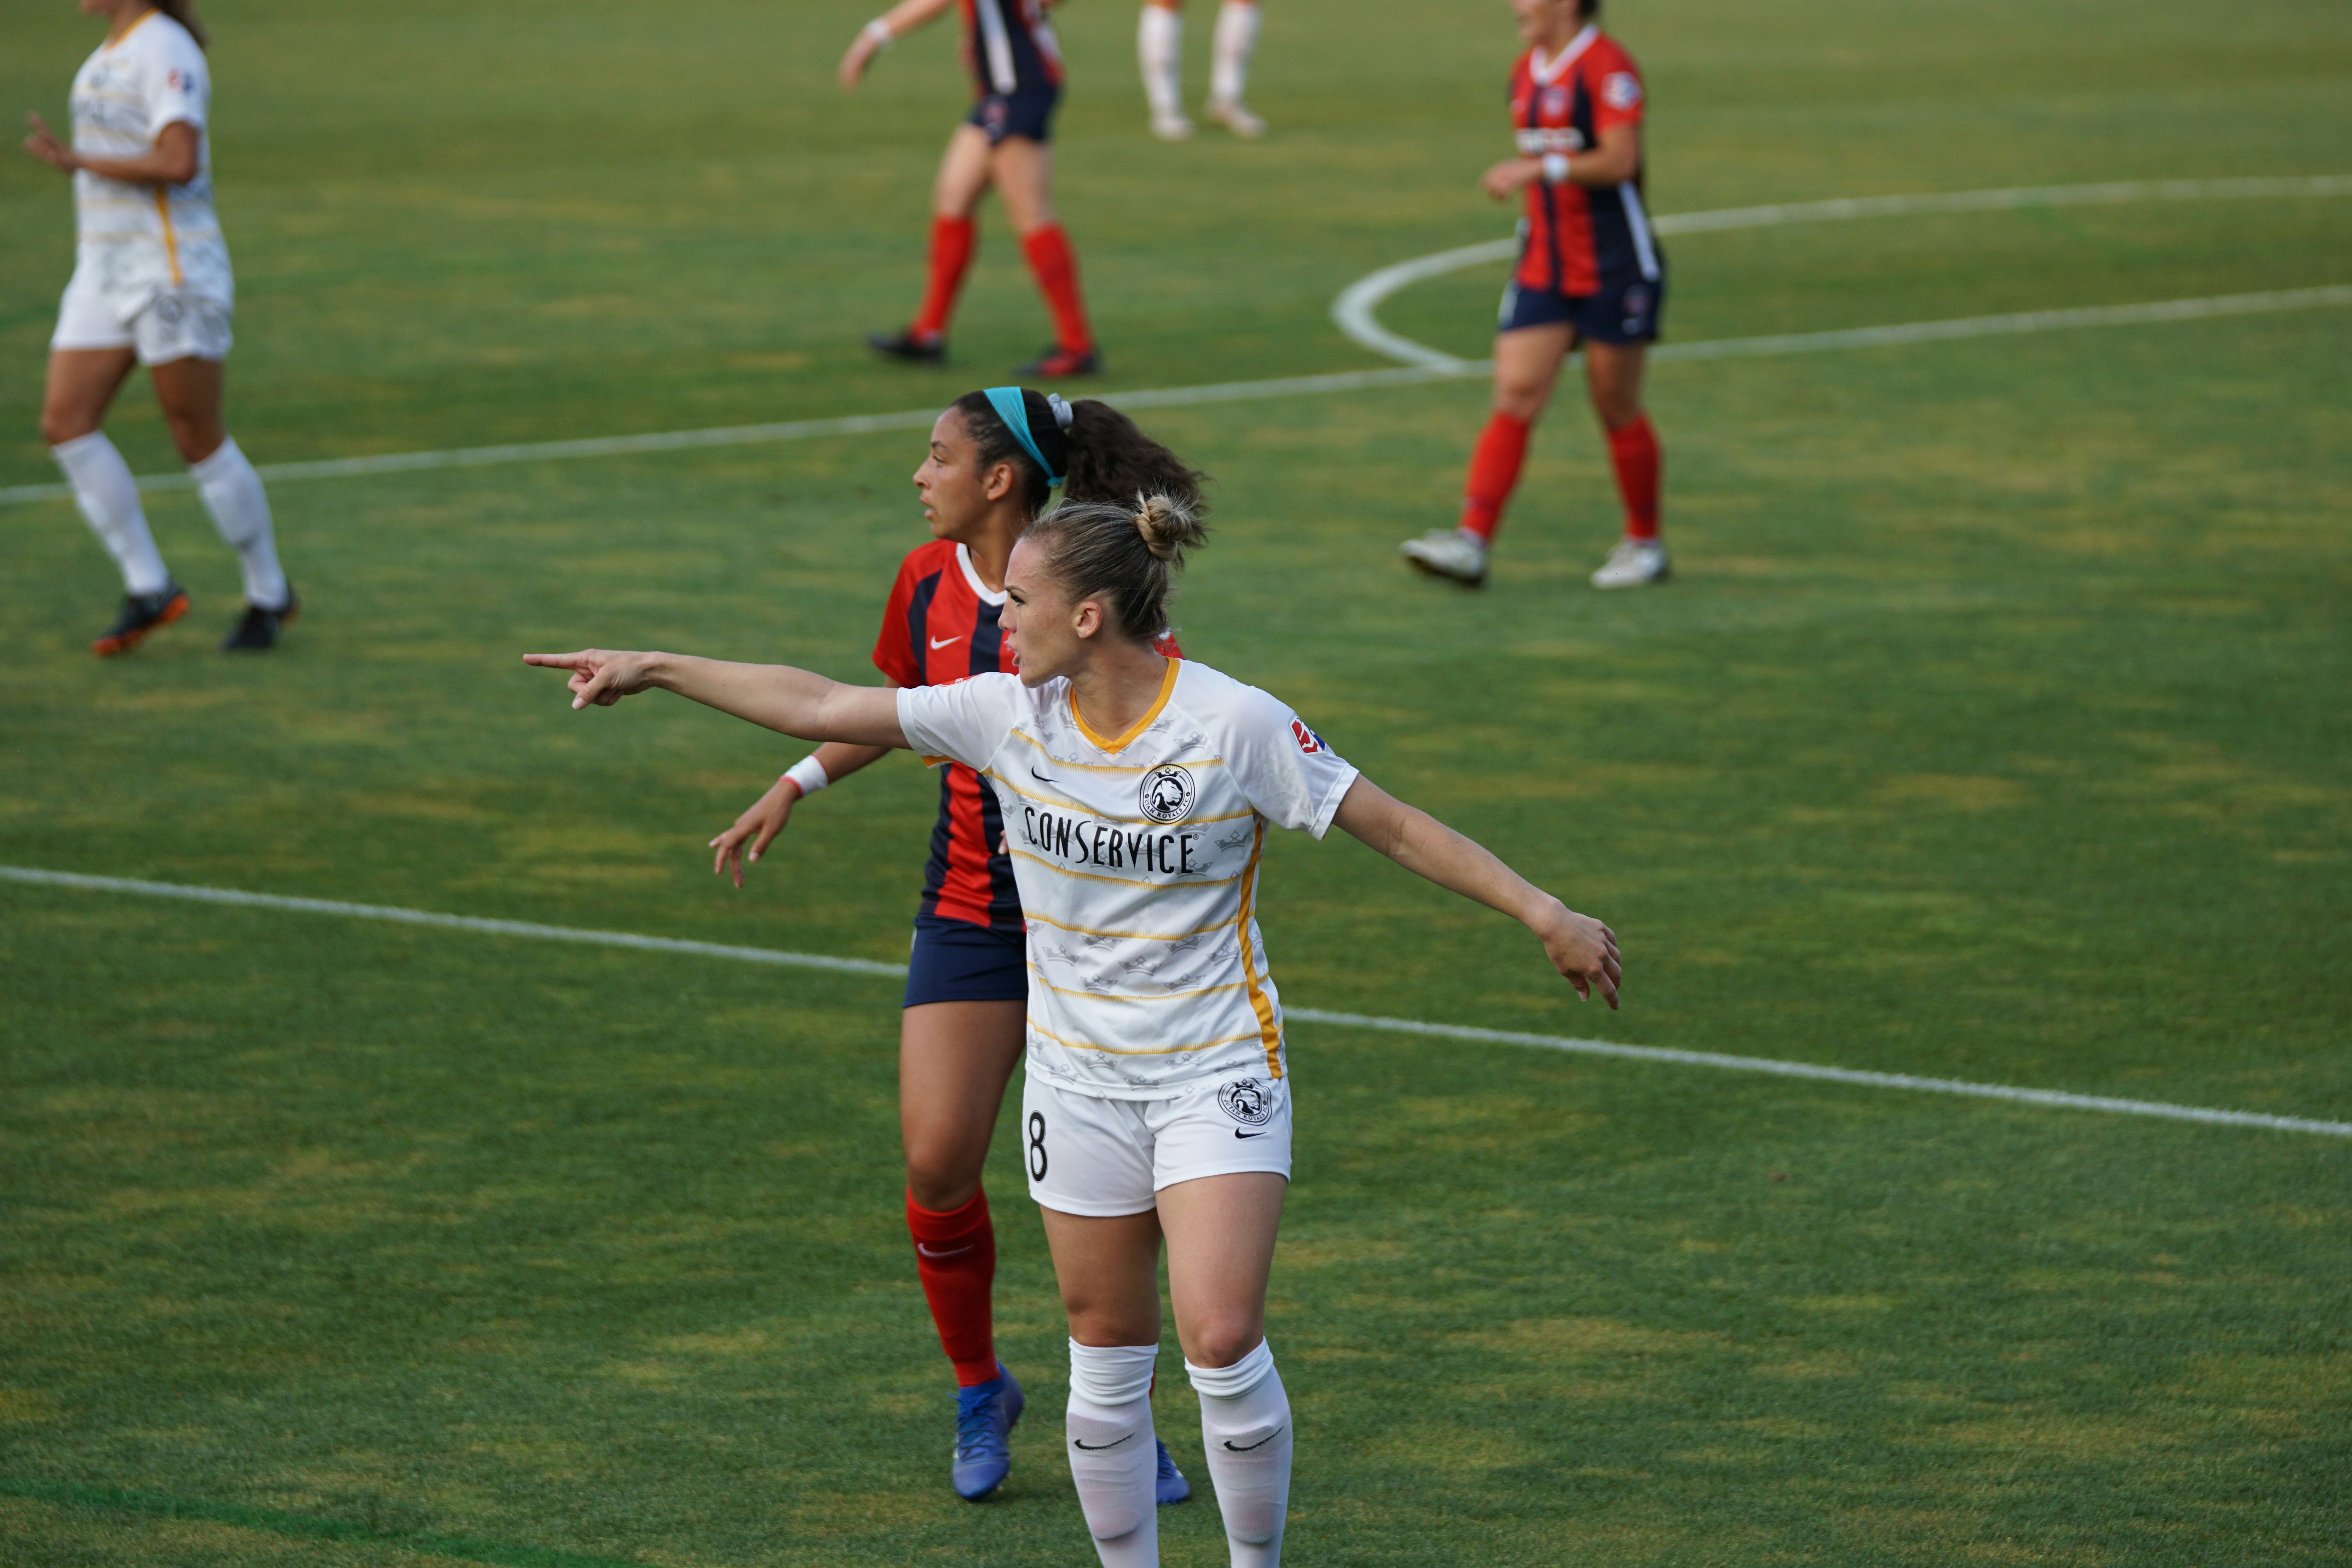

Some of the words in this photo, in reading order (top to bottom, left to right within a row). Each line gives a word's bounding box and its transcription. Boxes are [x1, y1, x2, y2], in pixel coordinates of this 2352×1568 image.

[1144, 799, 1155, 813] UTAH
[1157, 808, 1182, 818] ROYALS
[1183, 797, 1189, 806] FC
[1226, 1102, 1240, 1116] UTAH
[1029, 1110, 1048, 1183] 8
